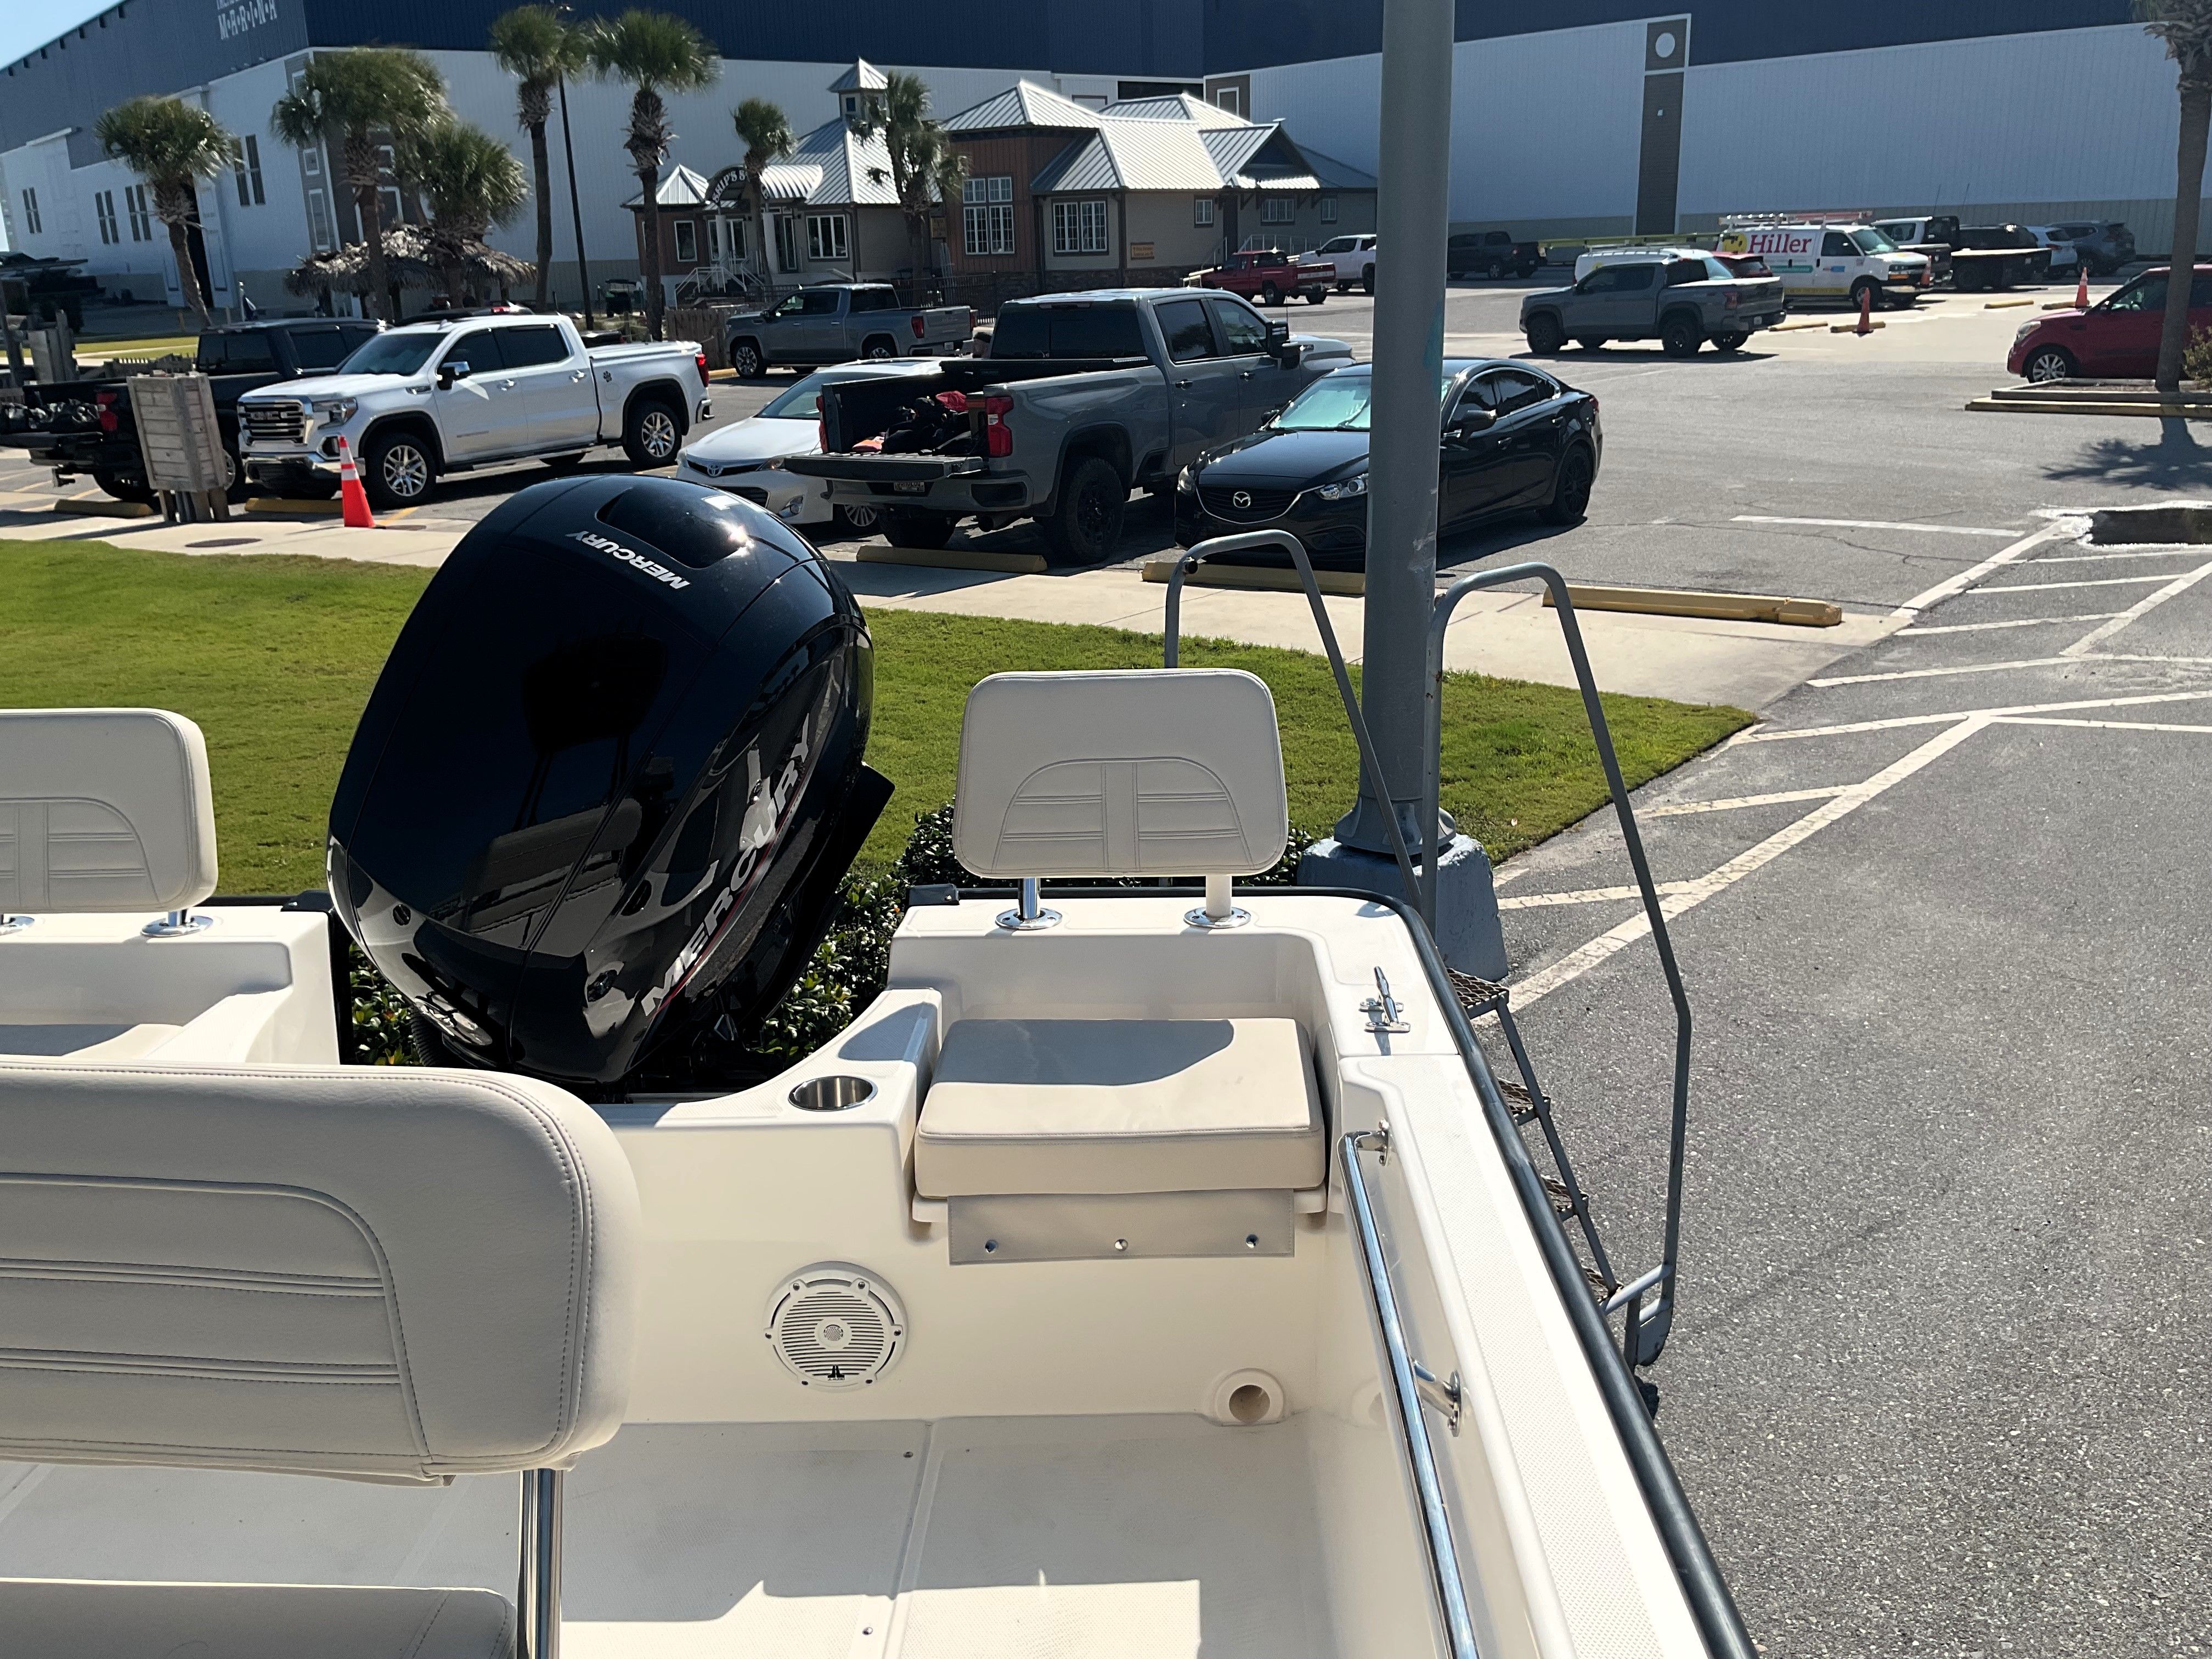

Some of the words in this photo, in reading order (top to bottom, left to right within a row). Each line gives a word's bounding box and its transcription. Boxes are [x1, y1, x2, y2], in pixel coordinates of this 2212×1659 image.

[1747, 233, 1812, 253] Hiller
[565, 531, 690, 589] MERCURY
[641, 713, 809, 1017] MERCURY
